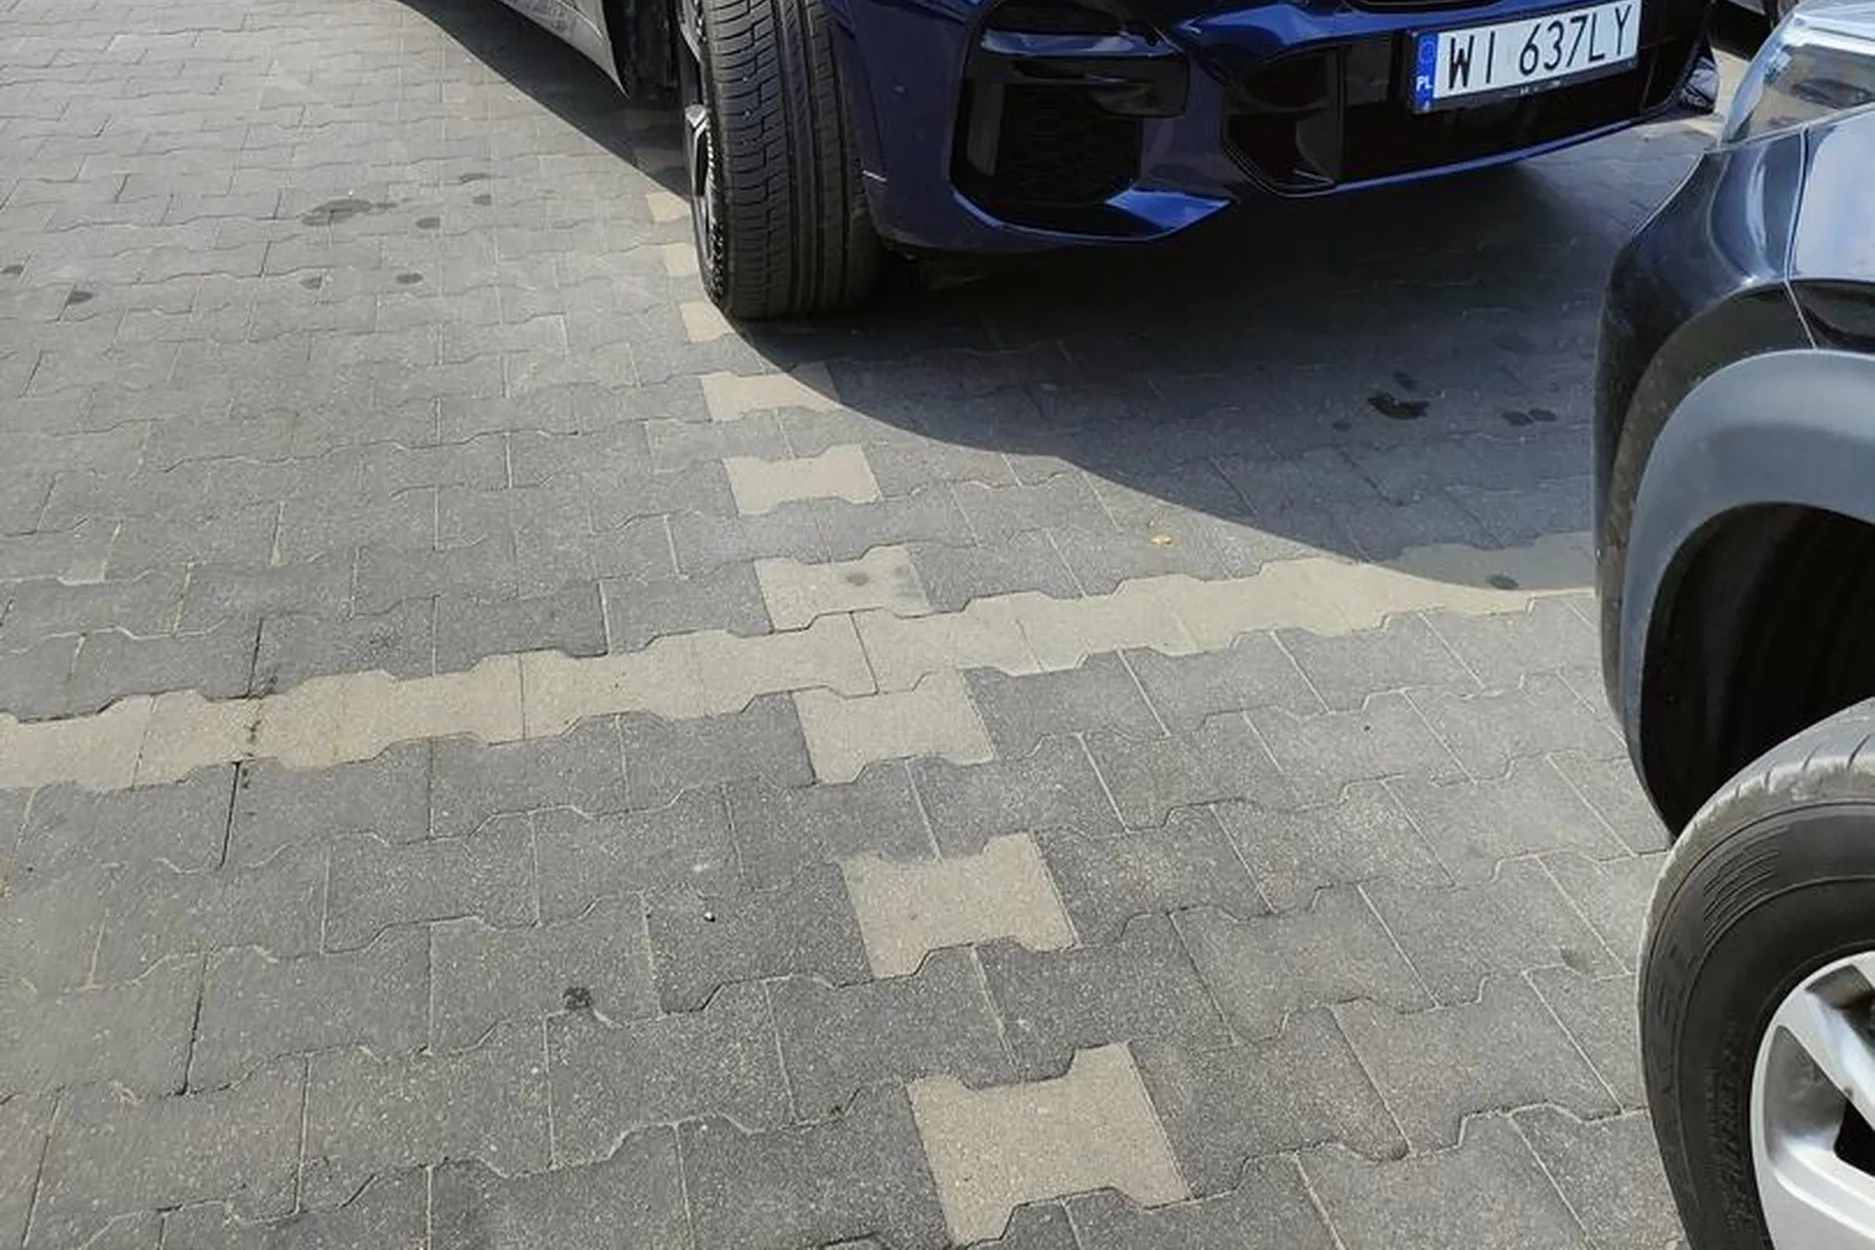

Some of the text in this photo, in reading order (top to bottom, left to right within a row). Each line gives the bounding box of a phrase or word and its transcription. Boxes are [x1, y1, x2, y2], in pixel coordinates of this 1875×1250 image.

[1449, 3, 1633, 90] WI 637LY
[1415, 75, 1432, 91] PL
